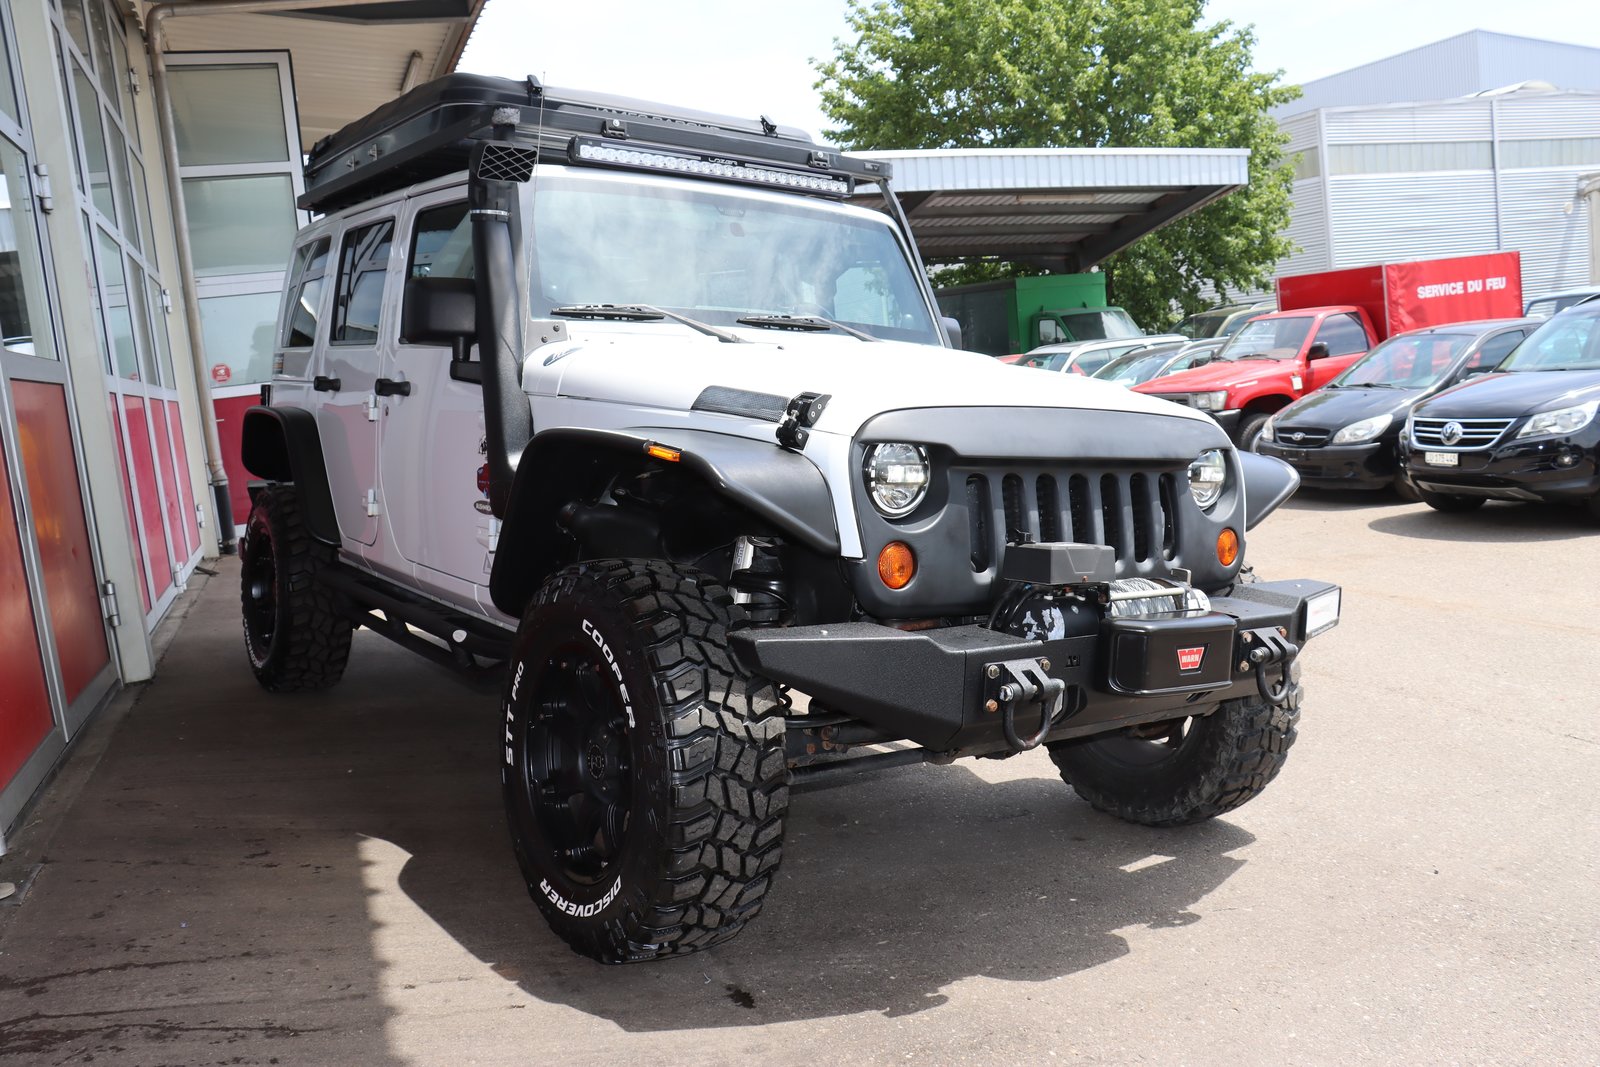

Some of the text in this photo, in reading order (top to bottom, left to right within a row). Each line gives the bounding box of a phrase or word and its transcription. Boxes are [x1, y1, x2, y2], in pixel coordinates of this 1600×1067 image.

[1417, 276, 1506, 299] SERVICE DU FEU
[582, 619, 635, 728] COOPER
[1181, 653, 1200, 663] WARN
[505, 661, 524, 767] STT PRO
[539, 874, 621, 918] DISCOVERER
